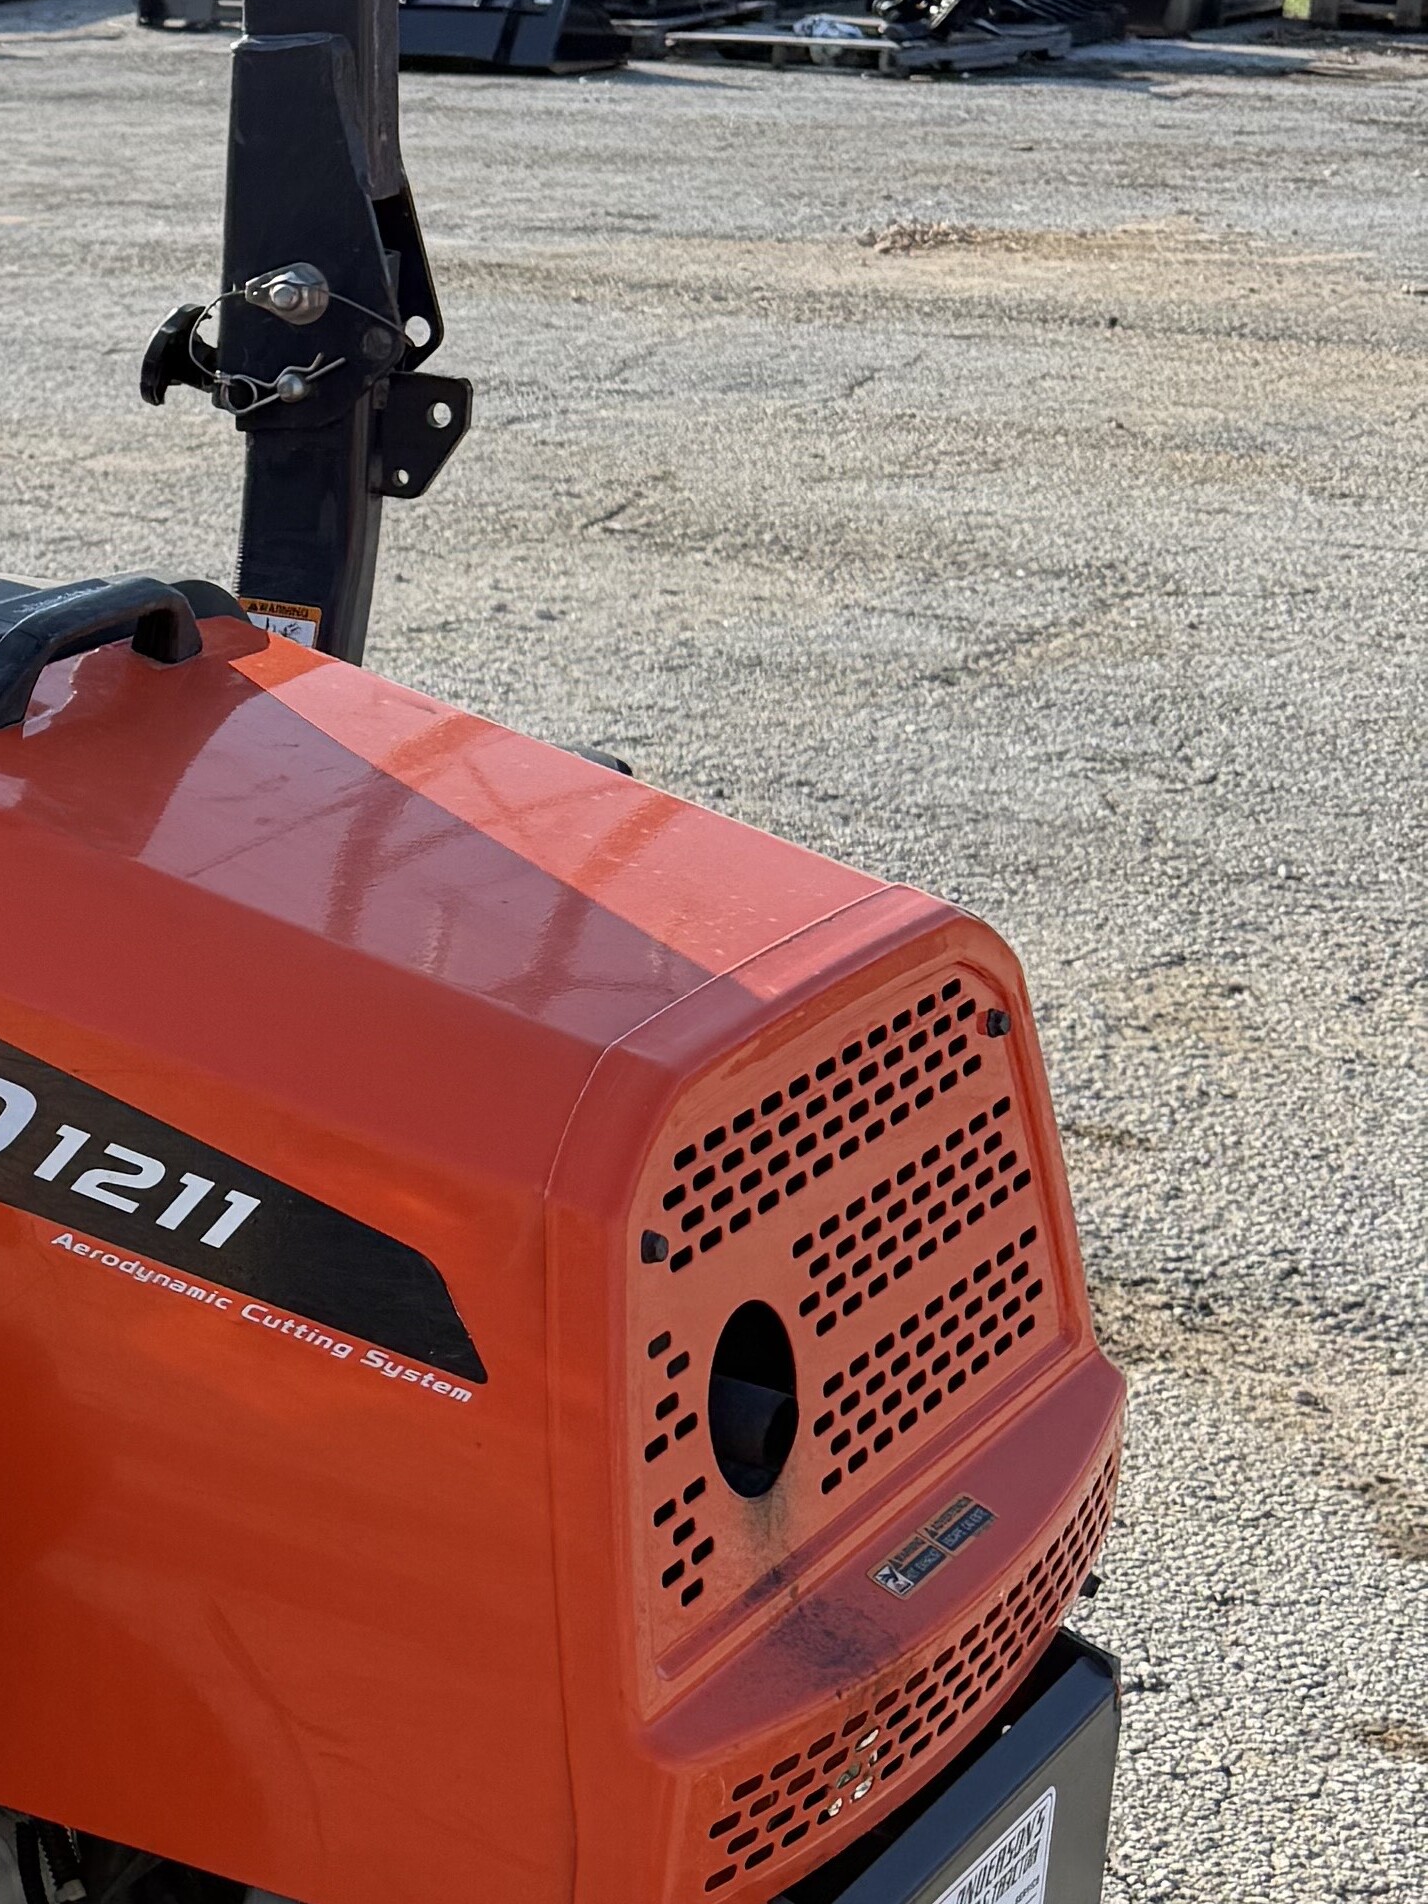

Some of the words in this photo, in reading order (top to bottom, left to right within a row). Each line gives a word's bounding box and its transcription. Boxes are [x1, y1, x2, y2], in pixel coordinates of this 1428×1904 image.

[51, 1232, 232, 1312] Aerodynamic
[241, 1302, 354, 1360] Cutting
[359, 1348, 474, 1404] System
